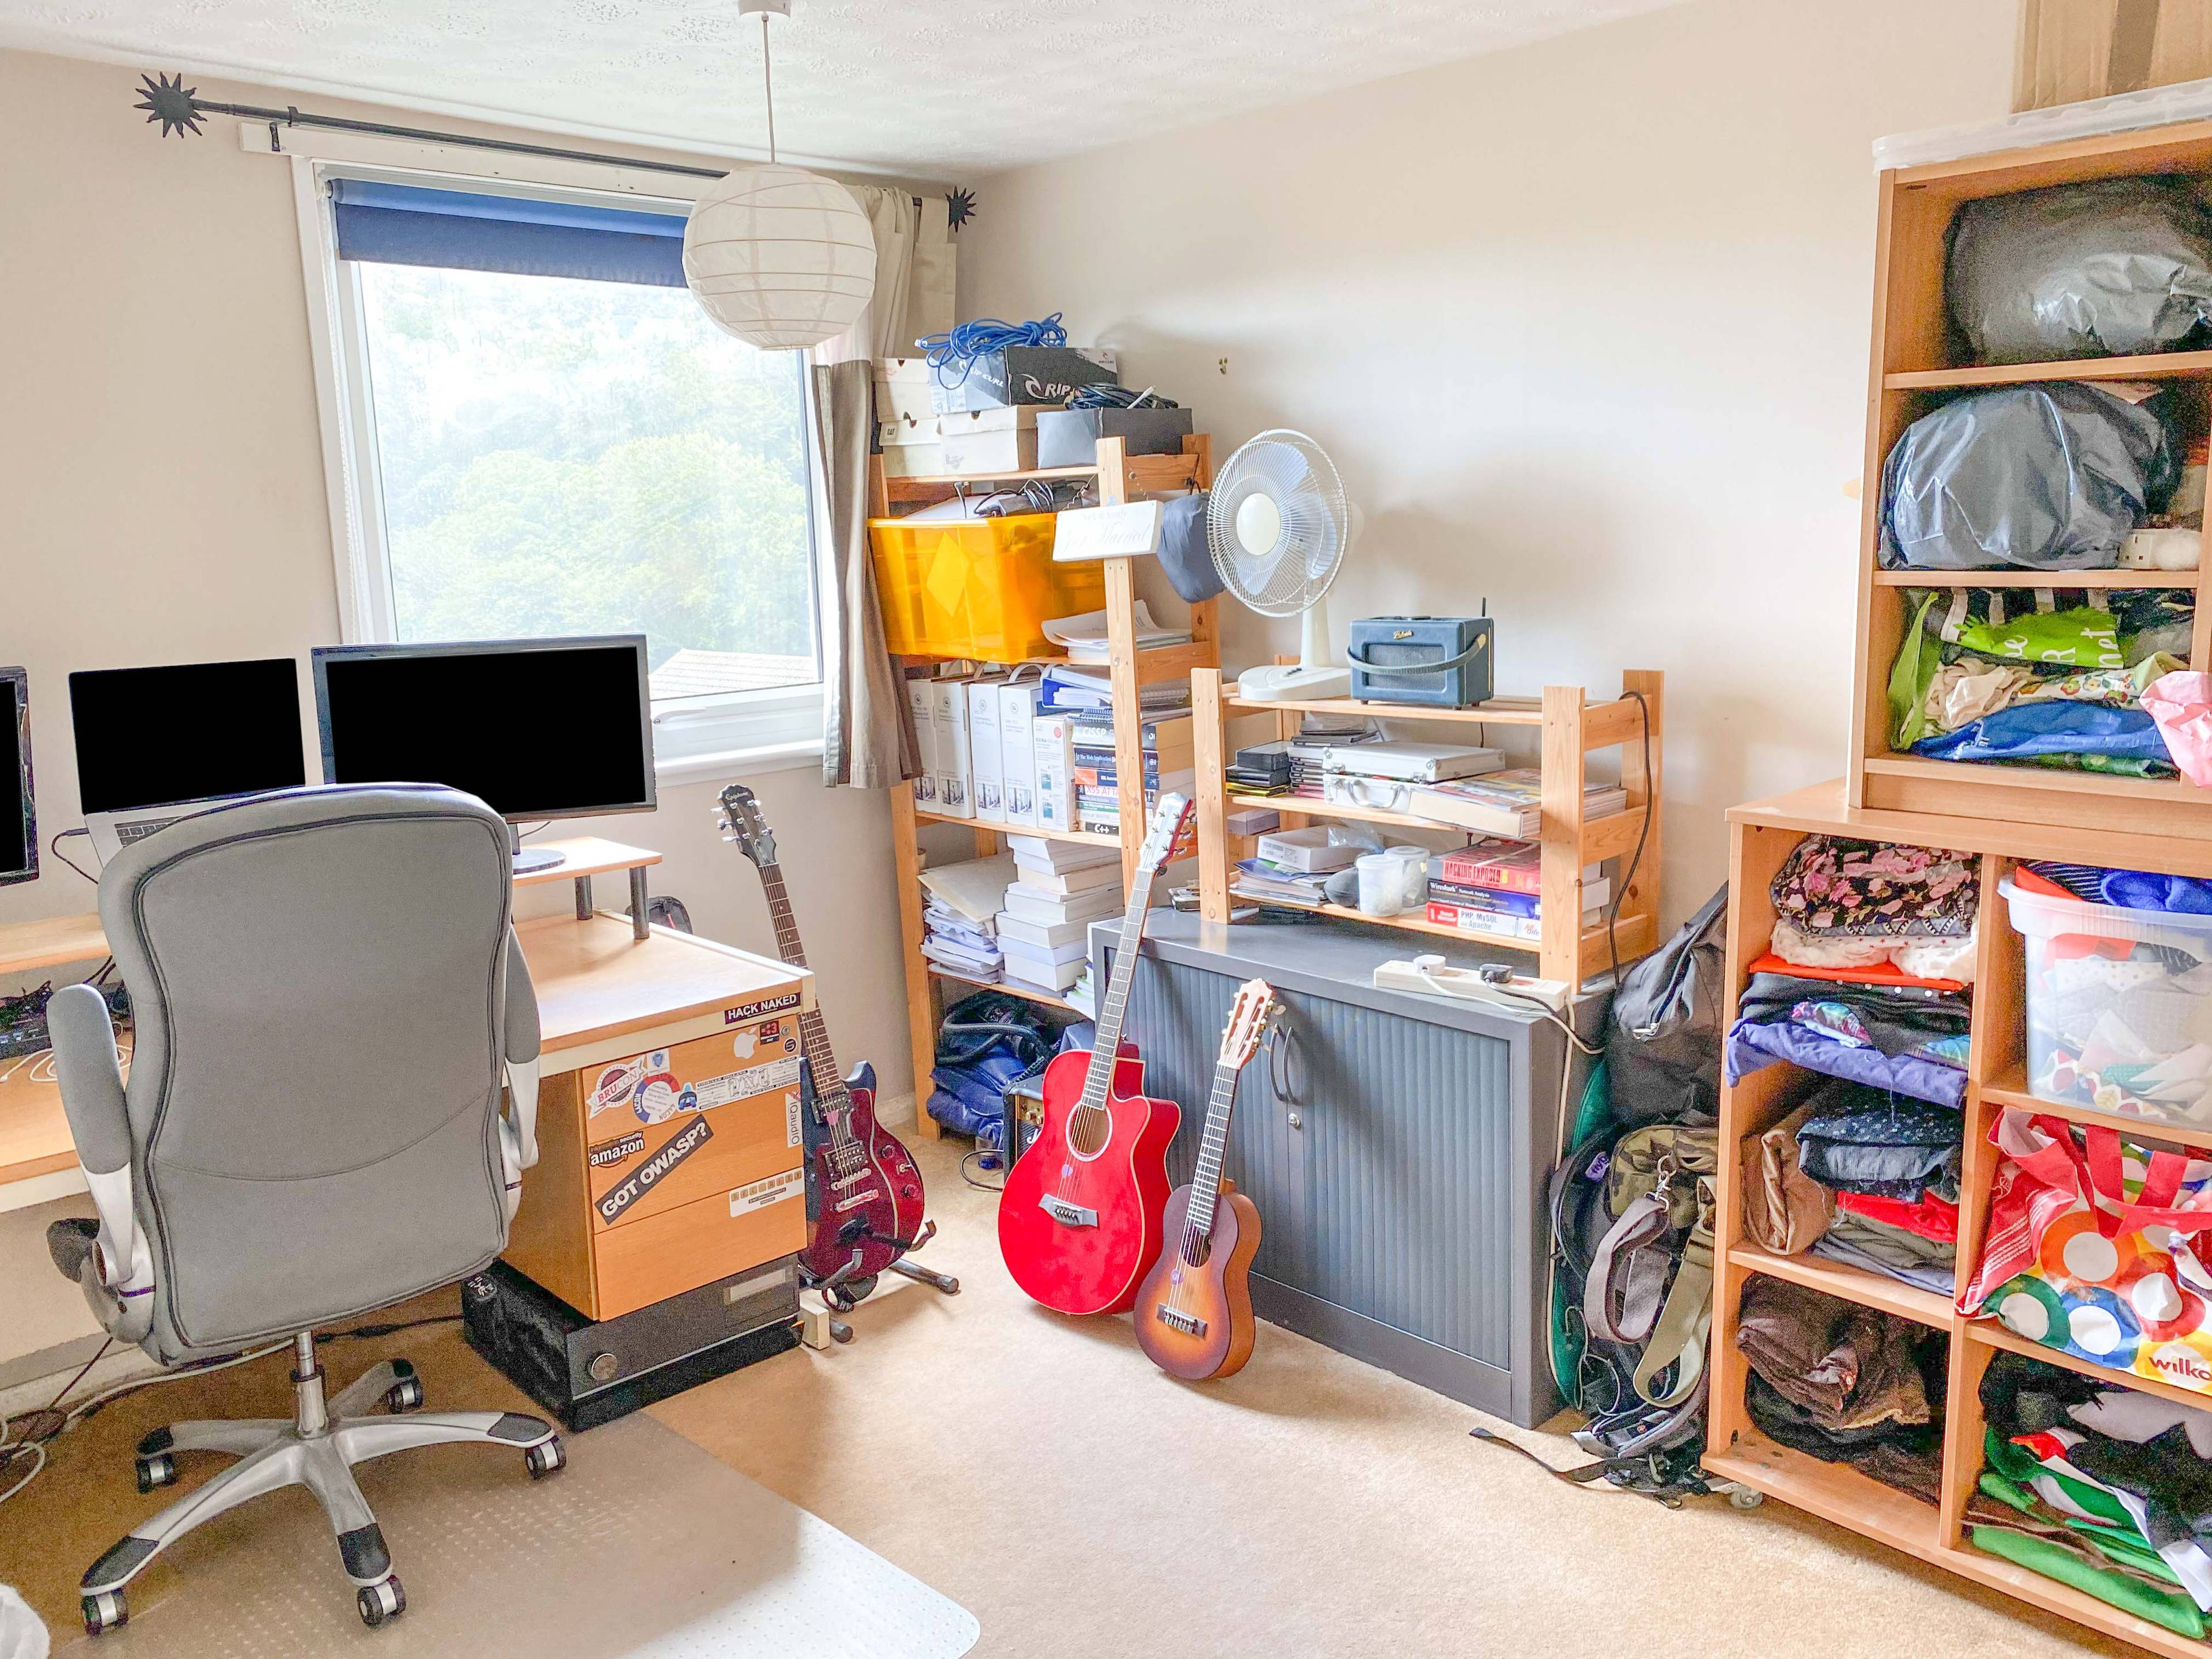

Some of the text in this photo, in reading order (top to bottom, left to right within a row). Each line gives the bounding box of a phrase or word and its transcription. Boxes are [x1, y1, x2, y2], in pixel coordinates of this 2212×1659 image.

[982, 374, 1005, 388] CURL
[1044, 382, 1071, 398] RIP
[1082, 726, 1107, 738] CISSP
[1086, 785, 1100, 794] XSS
[1094, 824, 1110, 834] C++
[1444, 862, 1472, 878] HACKING
[1473, 865, 1501, 883] EXPOSED
[1476, 912, 1498, 923] MySQL
[1468, 921, 1492, 931] Apache
[728, 1003, 759, 1020] HACK
[760, 994, 797, 1012] NAKED
[597, 1070, 638, 1104] BRUCON
[619, 1131, 643, 1143] security
[590, 1138, 645, 1166] amazon
[601, 1122, 707, 1217] GOT OWASP?
[2148, 1357, 2212, 1381] wilko
